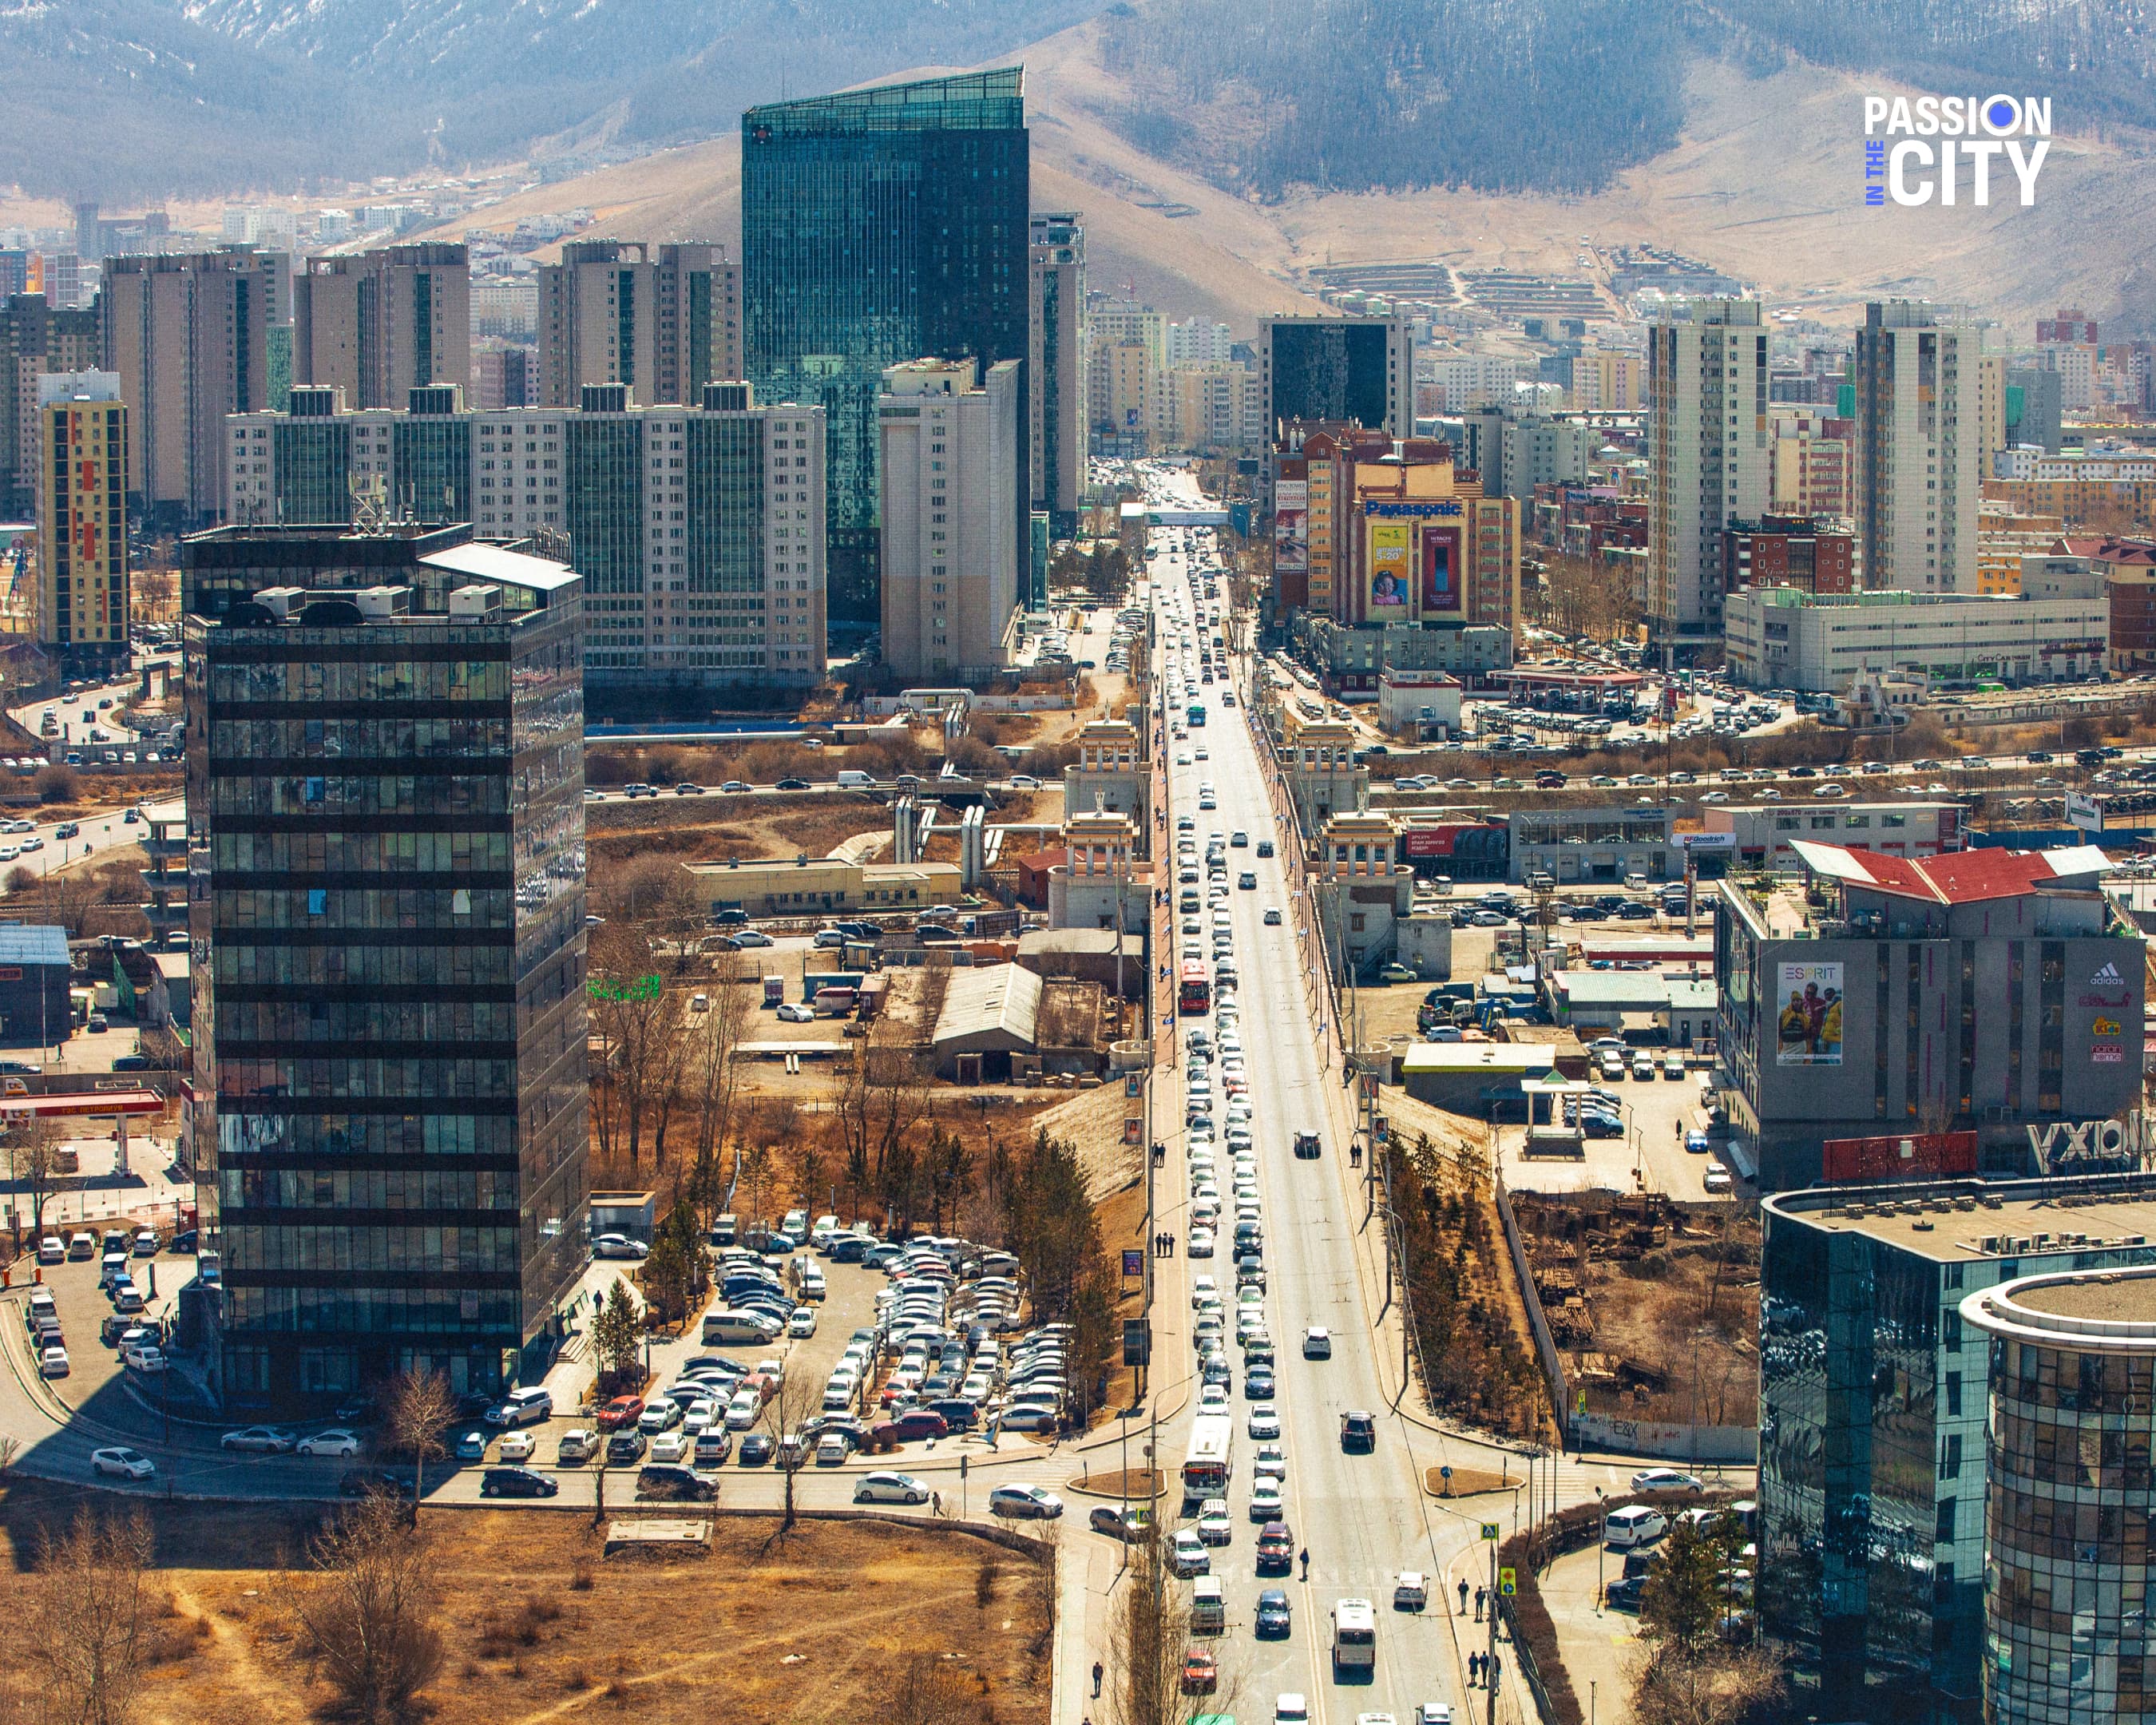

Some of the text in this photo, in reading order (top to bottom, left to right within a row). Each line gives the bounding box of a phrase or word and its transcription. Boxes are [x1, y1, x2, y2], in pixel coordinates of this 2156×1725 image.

[783, 128, 867, 139] ХААН БАНК
[1366, 500, 1462, 517] Panasonic
[1785, 967, 1836, 979] ESPRIT
